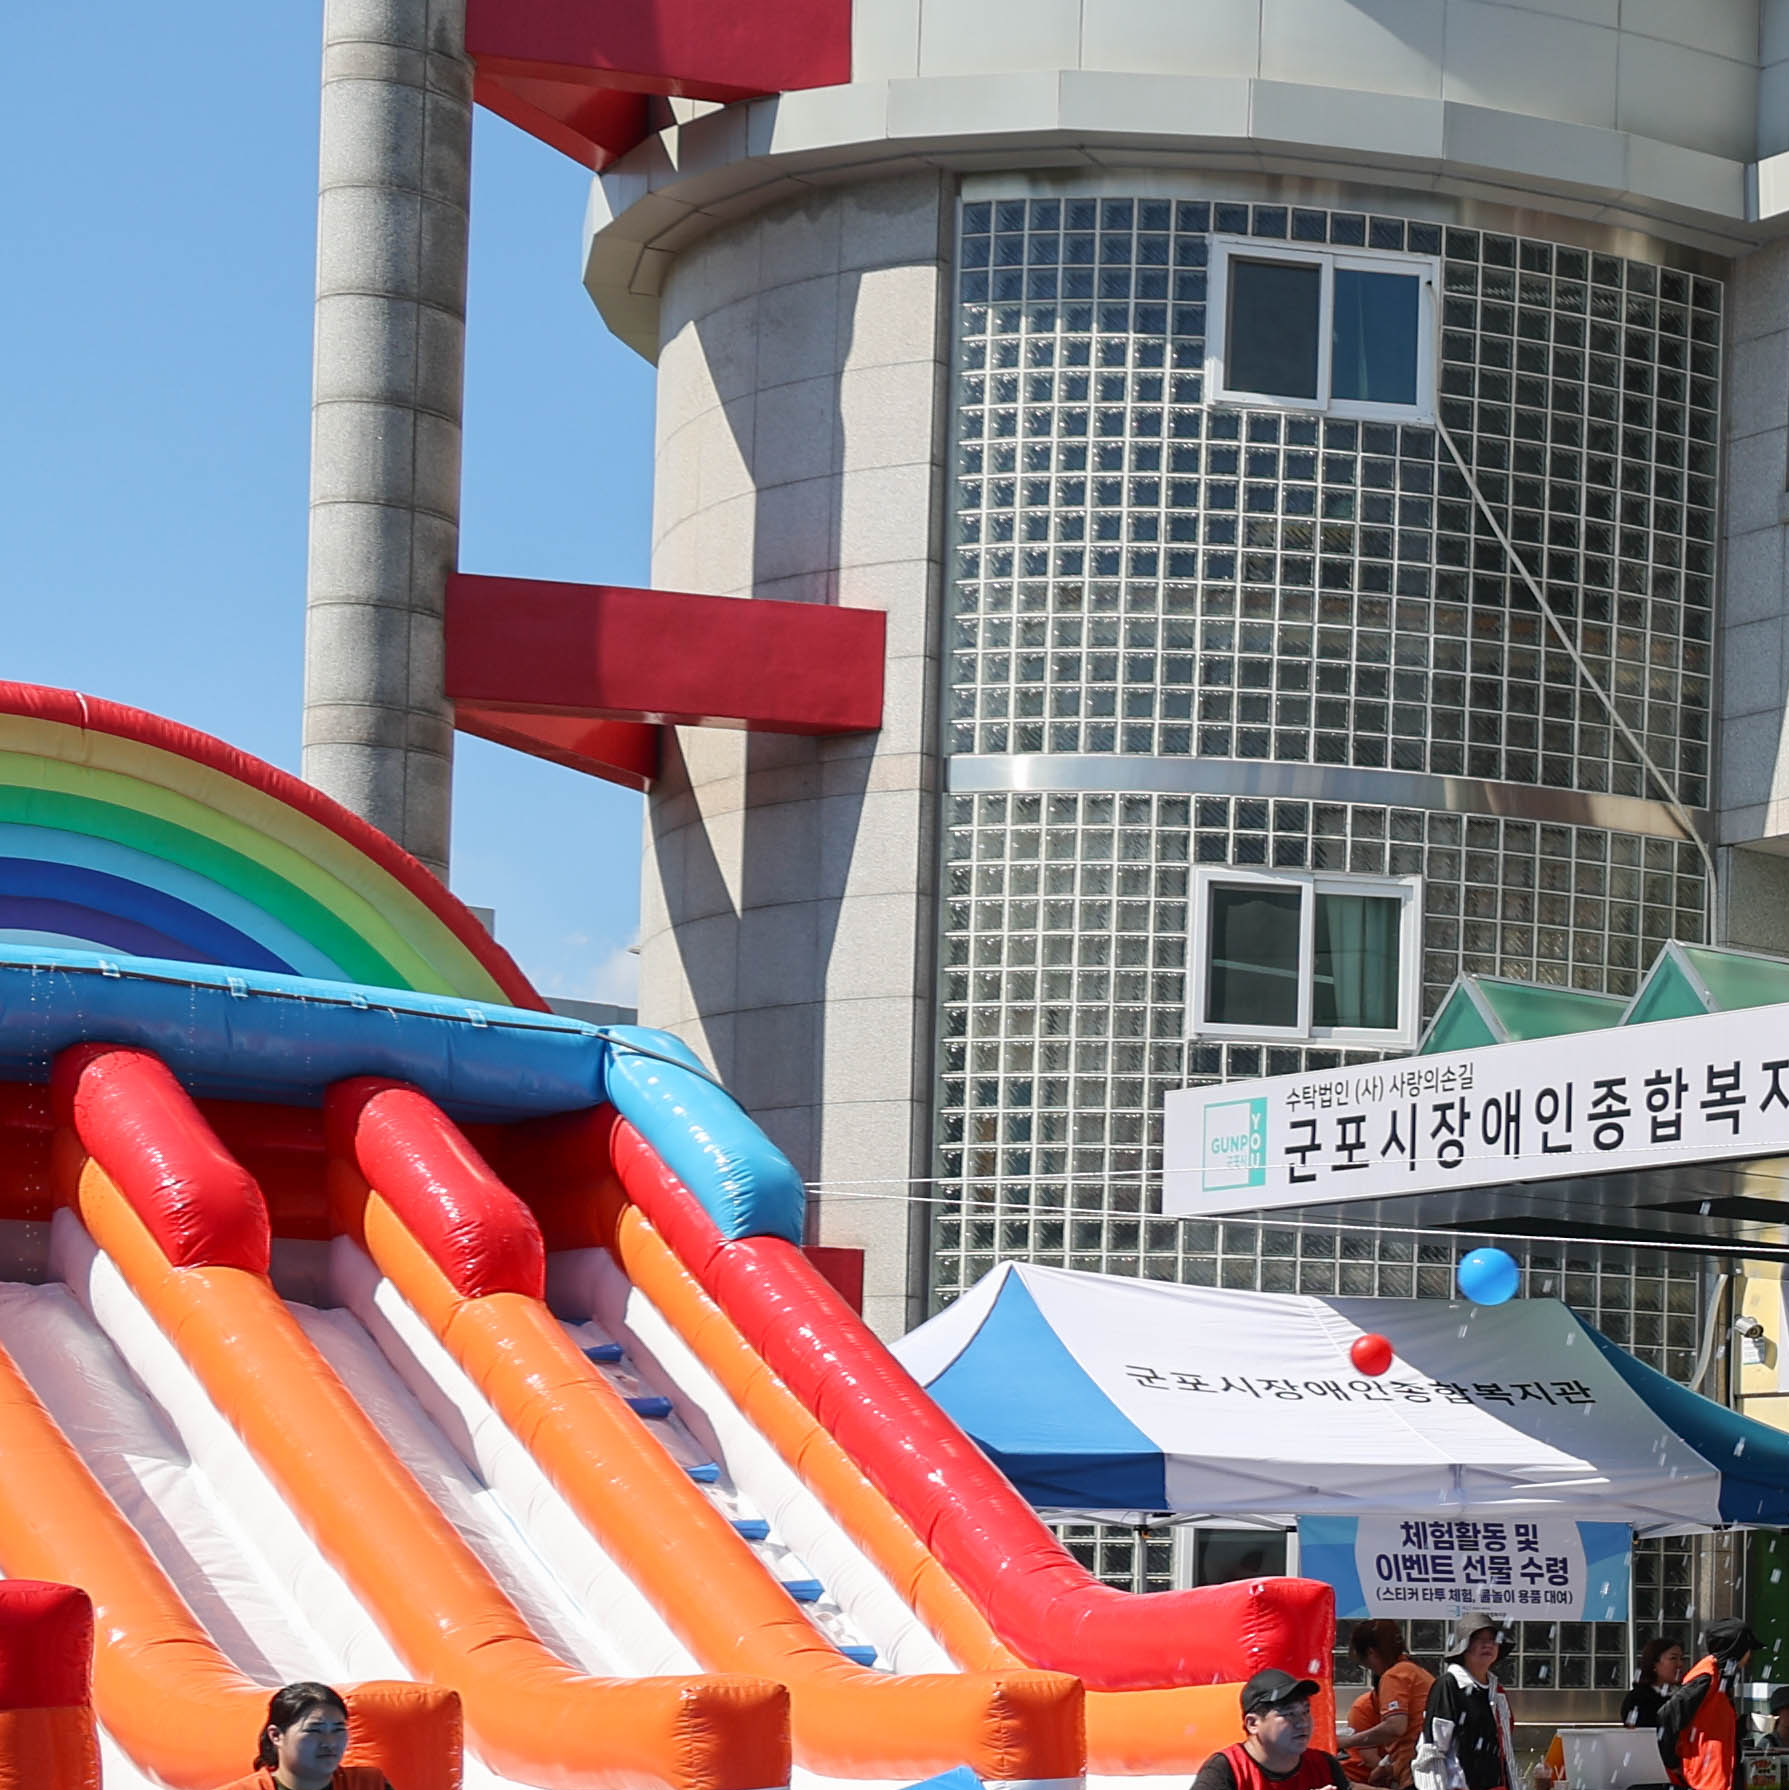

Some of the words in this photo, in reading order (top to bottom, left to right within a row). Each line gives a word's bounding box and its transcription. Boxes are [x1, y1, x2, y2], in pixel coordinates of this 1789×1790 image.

[1286, 1080, 1350, 1112] 수탁법인
[1355, 1075, 1384, 1104] (사)
[1389, 1063, 1474, 1098] 사랑의손길
[1125, 1365, 1598, 1405] 군포시장애인종합복지관
[1400, 1521, 1507, 1552] 체험활동
[1514, 1524, 1539, 1553] 및
[1376, 1553, 1456, 1583] 이벤트
[1463, 1555, 1512, 1585] 선물
[1520, 1556, 1569, 1586] 수령
[1376, 1587, 1419, 1602] (스티커
[1422, 1588, 1446, 1602] 타투
[1544, 1590, 1573, 1605] 대여)
